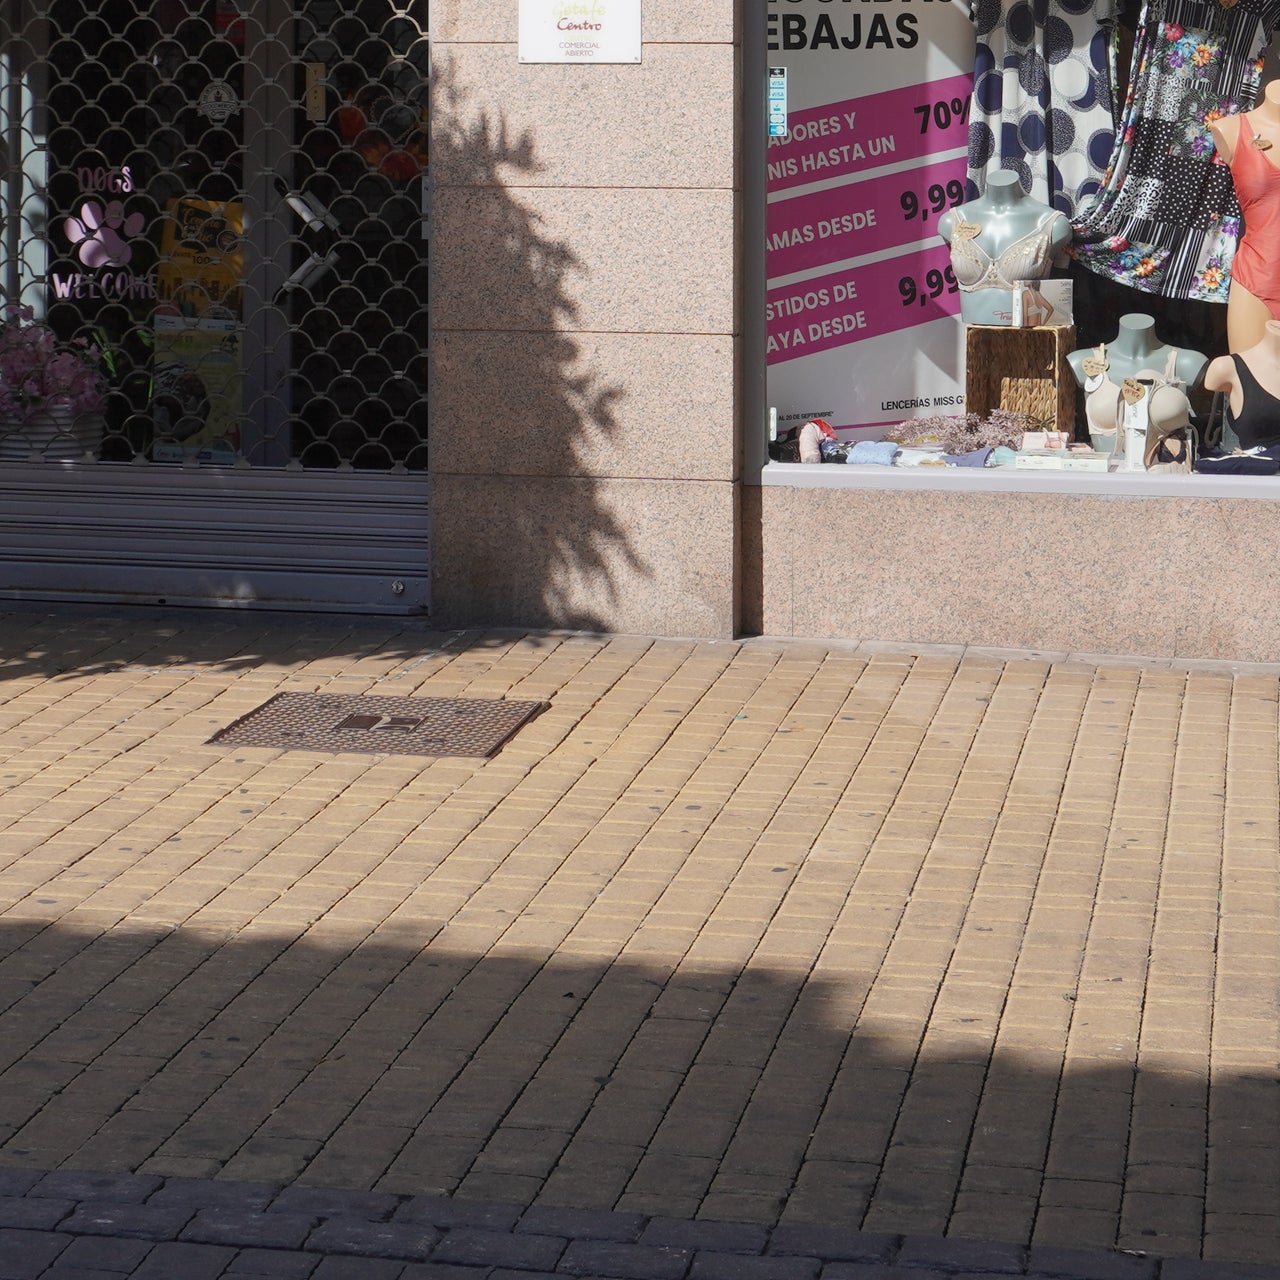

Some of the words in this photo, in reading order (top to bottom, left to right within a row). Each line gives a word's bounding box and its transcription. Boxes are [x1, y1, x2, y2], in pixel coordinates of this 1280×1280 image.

[556, 17, 602, 32] Centro
[558, 41, 601, 49] COMERCIAL
[843, 111, 857, 130] Y
[767, 157, 799, 181] NIS
[801, 143, 866, 173] HASTA
[869, 135, 896, 156] UN
[76, 165, 135, 193] DOGS
[816, 208, 877, 239] DESDE
[52, 271, 160, 301] WELCOME
[833, 281, 858, 303] DE
[766, 326, 806, 355] AYA
[808, 311, 867, 342] DESDE
[881, 397, 930, 413] LENCERÍAS
[933, 394, 955, 409] MISS
[956, 394, 966, 406] G
[793, 412, 801, 420] DE
